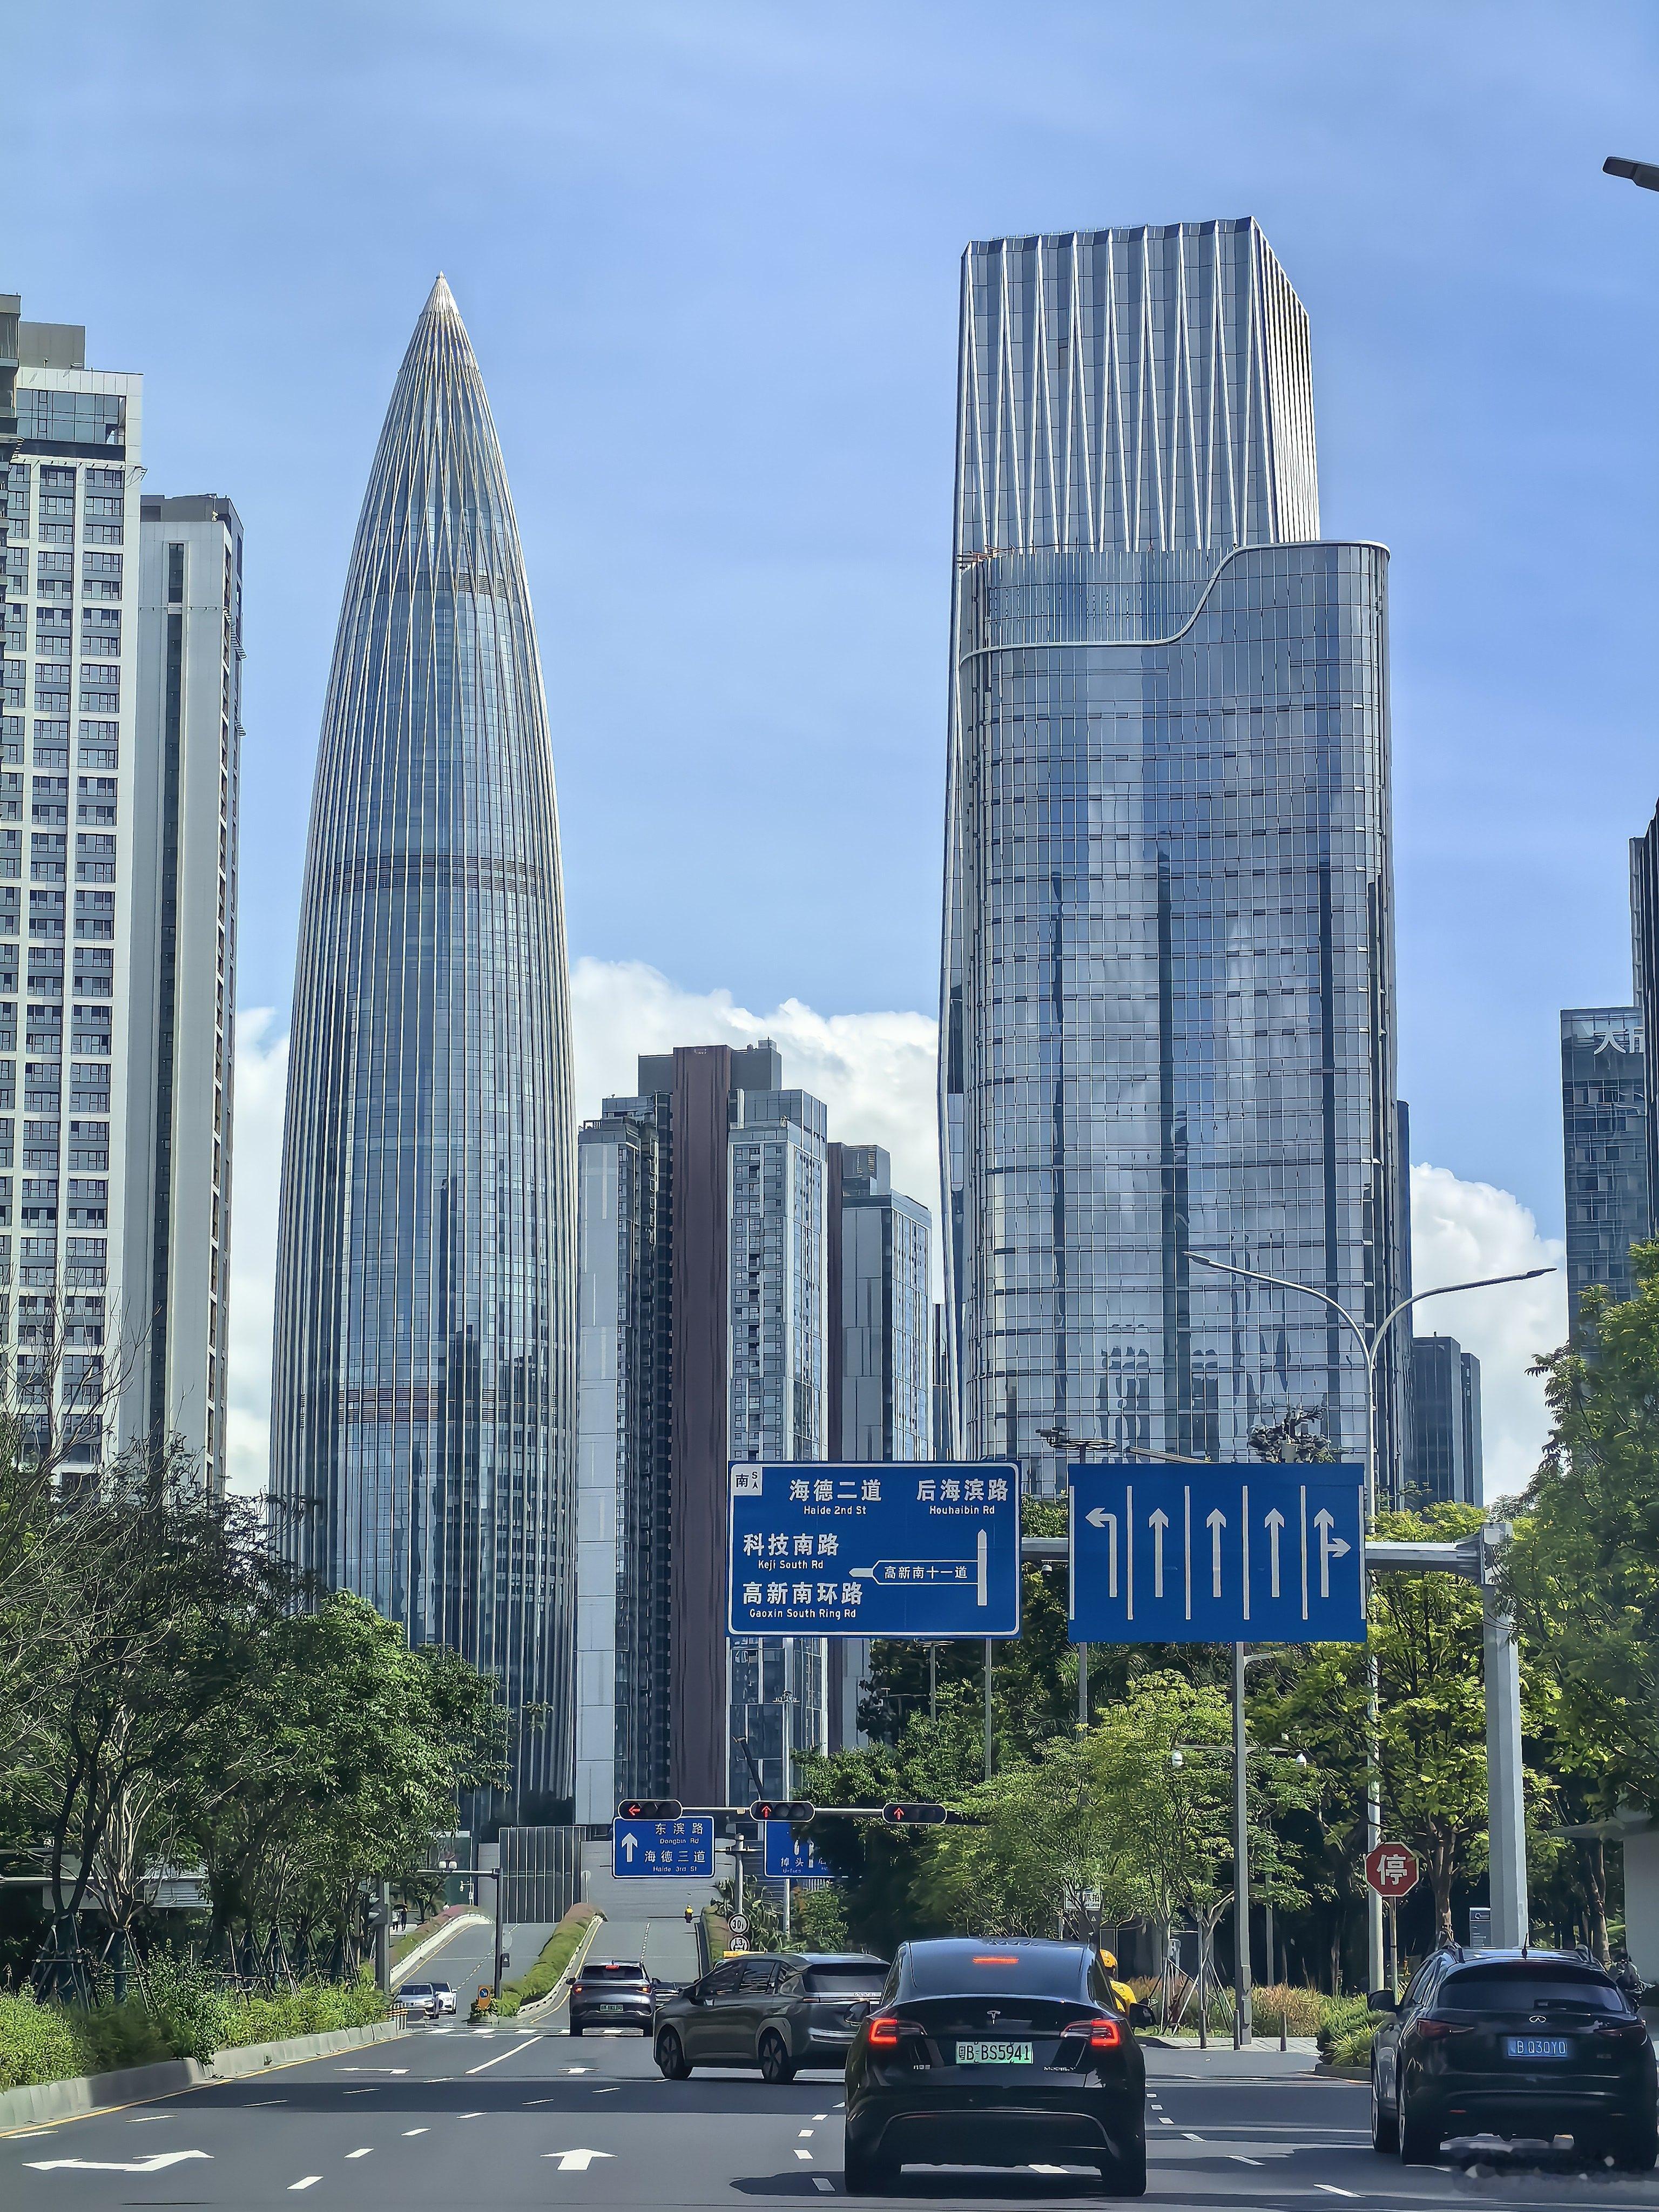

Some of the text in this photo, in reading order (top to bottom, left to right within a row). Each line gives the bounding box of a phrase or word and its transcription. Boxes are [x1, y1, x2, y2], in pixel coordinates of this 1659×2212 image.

[736, 1473, 749, 1488] 南
[752, 1471, 758, 1479] S
[789, 1479, 881, 1501] 海德二道
[916, 1478, 1008, 1501] 后海滨路
[804, 1505, 866, 1514] Haide 2nd St
[929, 1505, 995, 1514] Houhaibin Rd
[743, 1533, 839, 1556] 科技南路
[758, 1560, 824, 1571] Keji South Rd
[884, 1566, 968, 1579] 高新南十一道
[743, 1581, 863, 1605] 高新南环路
[750, 1608, 856, 1620] Gaoxin South Ring Rd
[655, 1823, 703, 1835] 东滨路
[644, 1850, 705, 1863] 海德三道
[1377, 1853, 1407, 1885] 停
